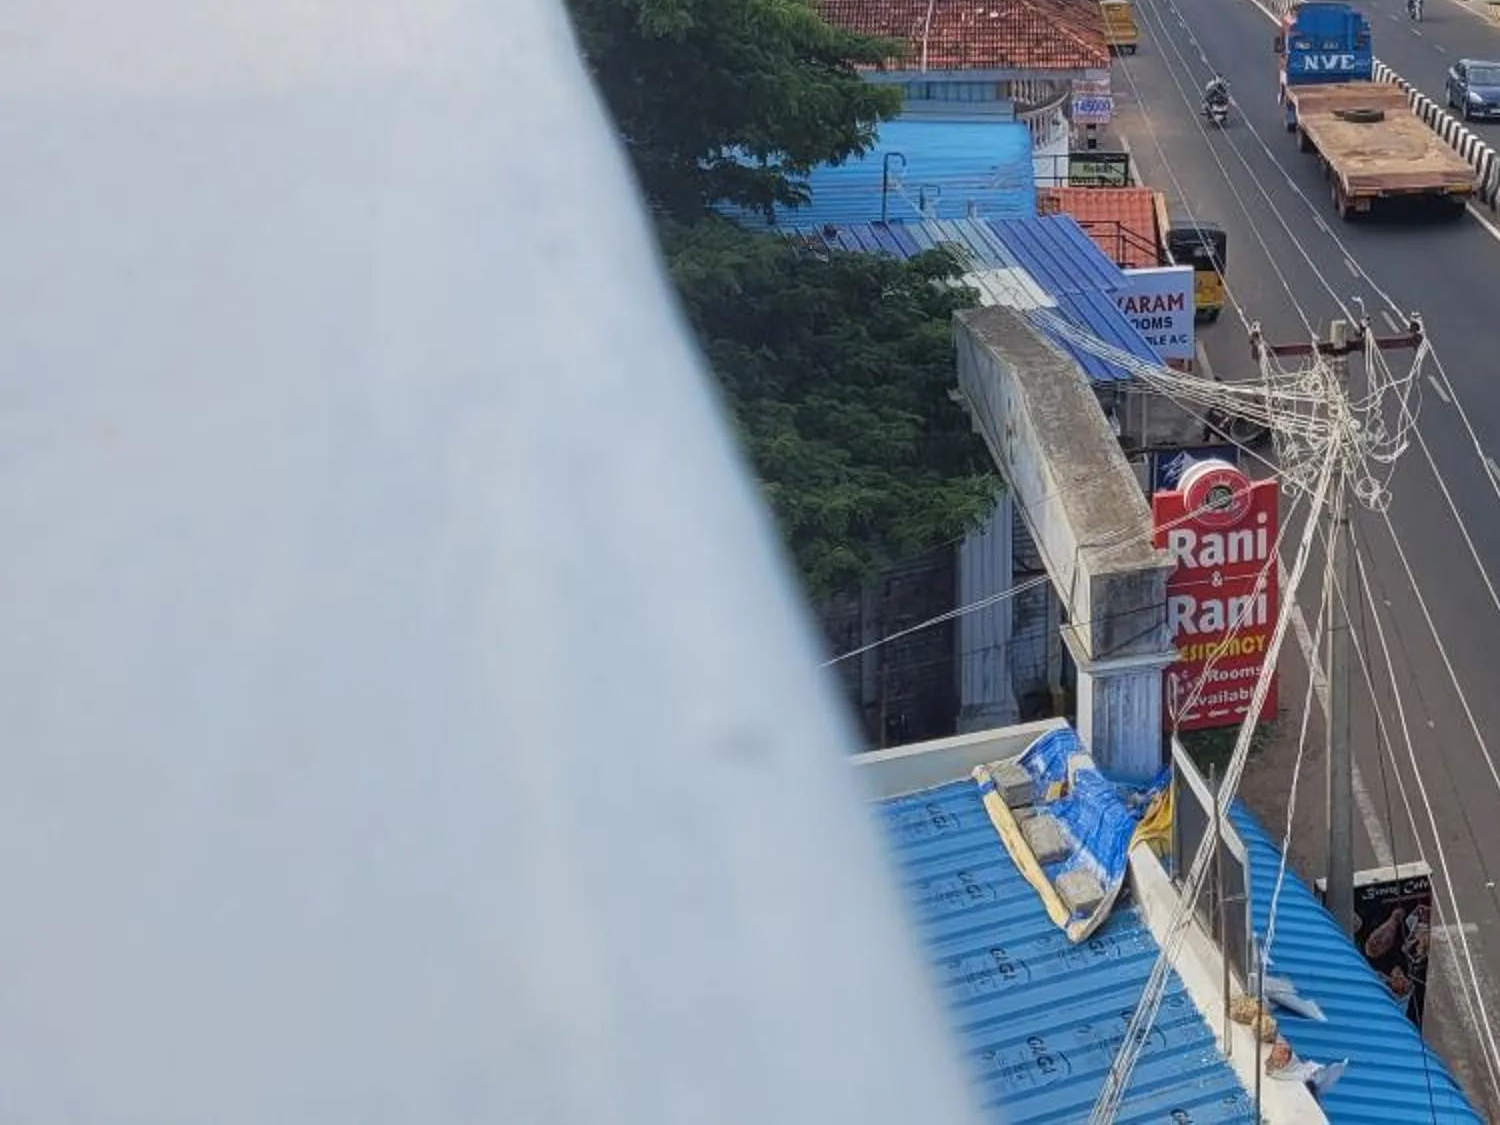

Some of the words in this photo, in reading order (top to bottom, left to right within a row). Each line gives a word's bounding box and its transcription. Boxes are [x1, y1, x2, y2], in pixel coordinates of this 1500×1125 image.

[1168, 512, 1268, 568] Rani
[1211, 571, 1223, 587] &
[1168, 577, 1268, 635] Rani
[1179, 634, 1267, 662] ESIDNCY
[1191, 686, 1256, 708] vailabl
